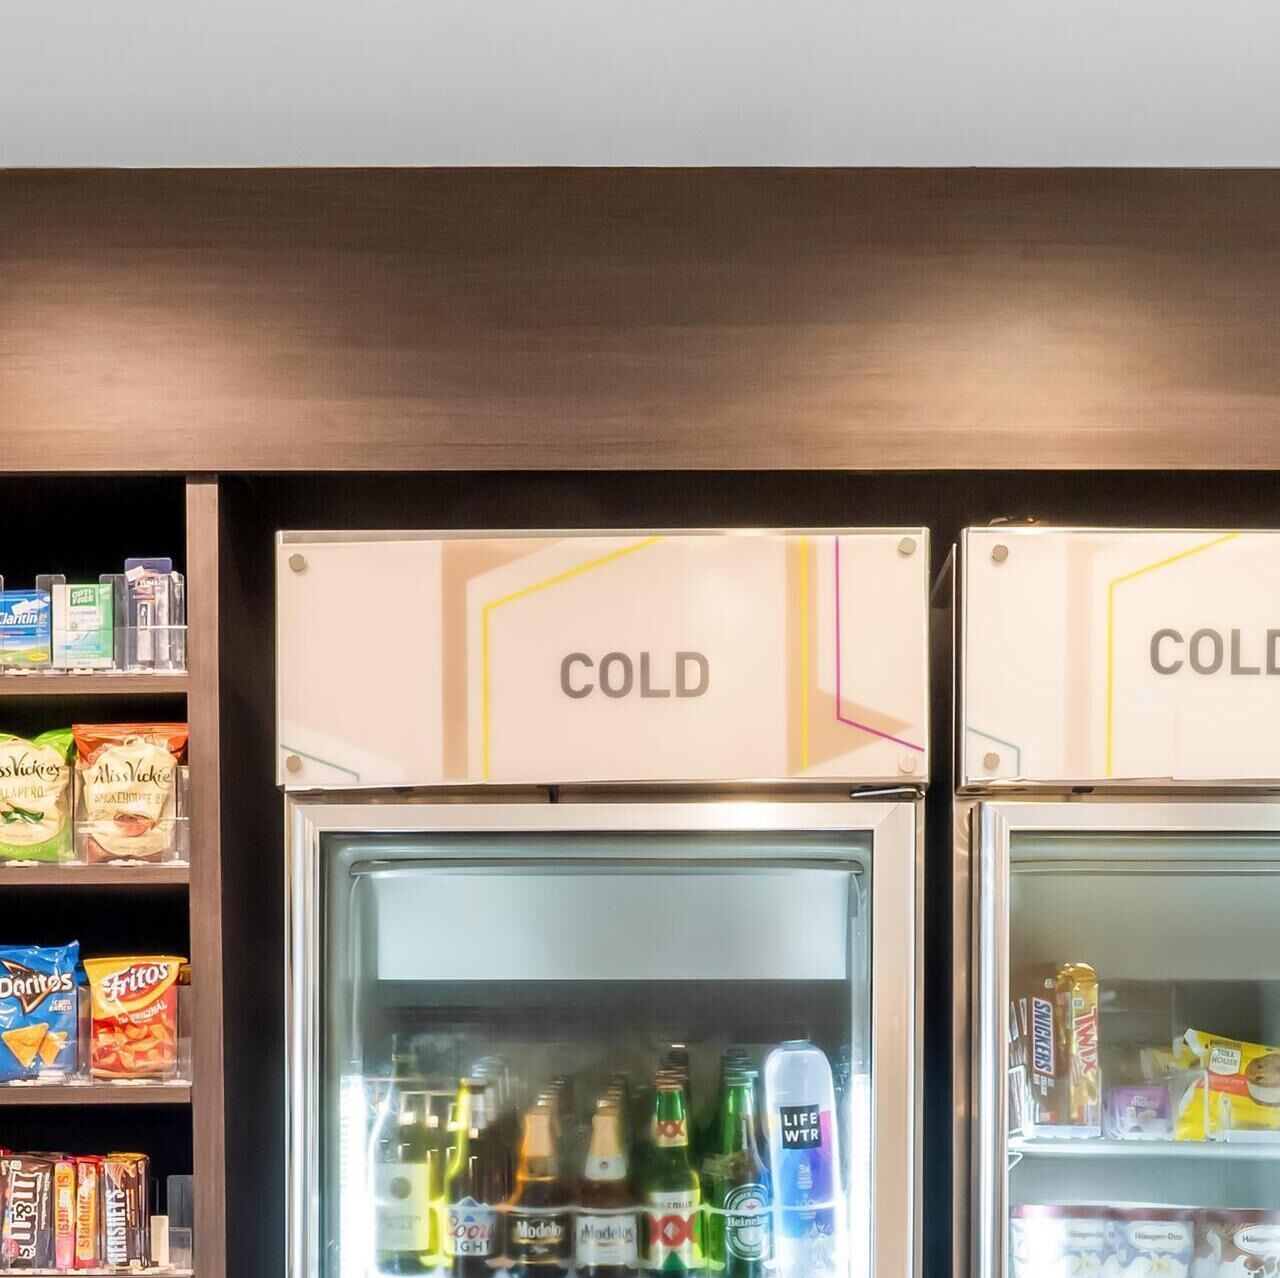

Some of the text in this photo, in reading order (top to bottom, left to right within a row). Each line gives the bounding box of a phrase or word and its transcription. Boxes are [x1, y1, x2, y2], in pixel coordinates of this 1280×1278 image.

[560, 651, 710, 699] COLD
[101, 963, 170, 1002] Fritos
[1032, 999, 1054, 1073] SNICKERS
[1075, 1005, 1098, 1073] TWIX
[783, 1112, 818, 1126] LIFE
[784, 1129, 819, 1142] WTR
[516, 1220, 561, 1239] Modelo
[727, 1216, 769, 1227] Heinek
